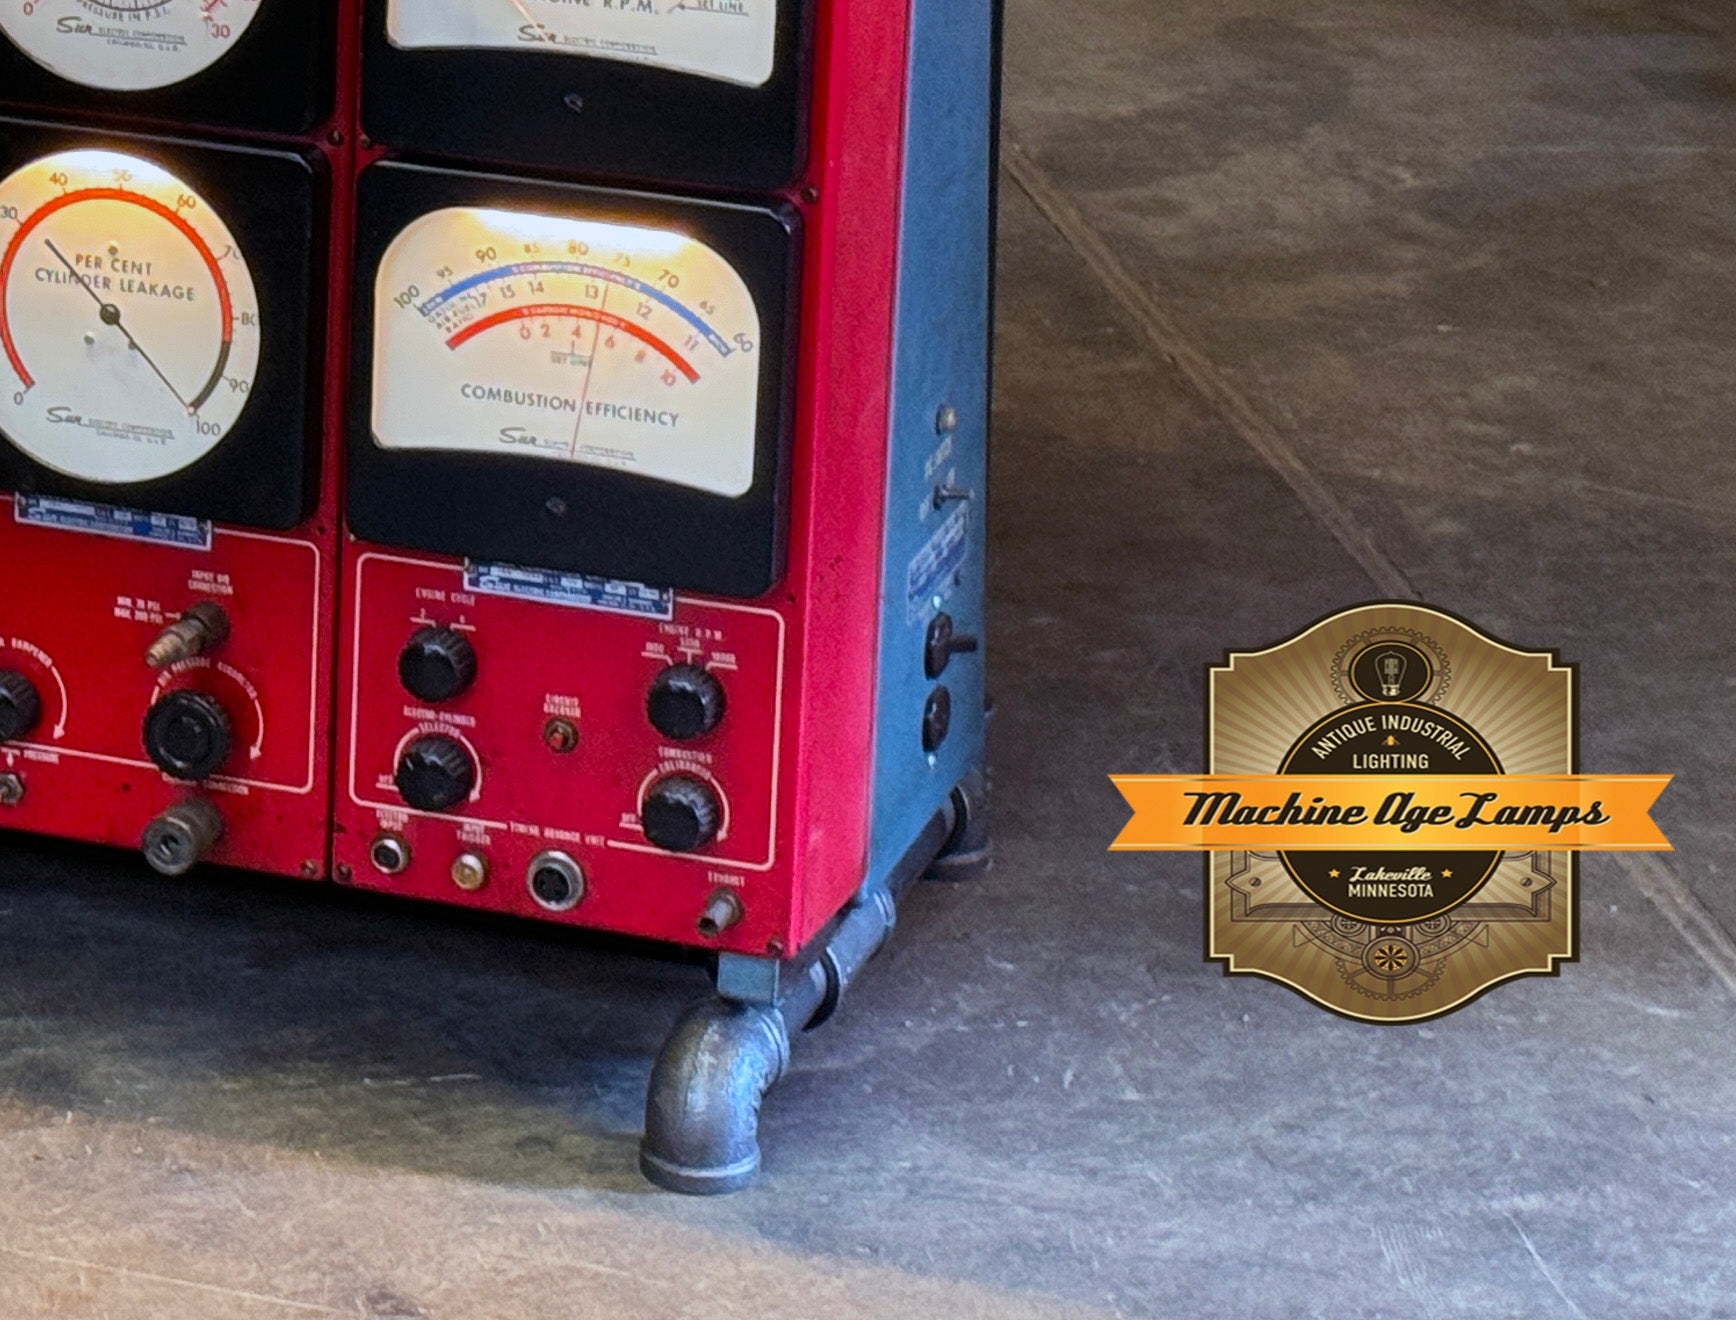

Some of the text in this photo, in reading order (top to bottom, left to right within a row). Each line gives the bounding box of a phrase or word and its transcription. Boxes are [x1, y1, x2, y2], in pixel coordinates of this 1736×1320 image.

[23, 2, 33, 16] 0
[211, 23, 231, 39] 30
[56, 16, 93, 34] Sun
[49, 172, 68, 186] 40
[176, 194, 196, 210] 60
[0, 206, 18, 221] 30
[75, 253, 153, 276] PER CENT
[34, 268, 195, 302] CYLINDER LEAKAGE
[393, 284, 421, 310] 100
[475, 245, 498, 262] 90
[568, 240, 590, 256] 80
[657, 268, 681, 289] 70
[529, 280, 546, 296] 14
[584, 284, 600, 300] 13
[635, 301, 653, 319] 12
[539, 323, 551, 338] 2
[570, 324, 582, 339] 4
[604, 334, 616, 349] 6
[229, 377, 250, 393] 90
[14, 392, 24, 406] 0
[460, 382, 680, 428] COMBUSTION EFFICIENCY
[46, 405, 83, 426] Sun
[195, 420, 221, 436] 100
[498, 426, 538, 446] Sun
